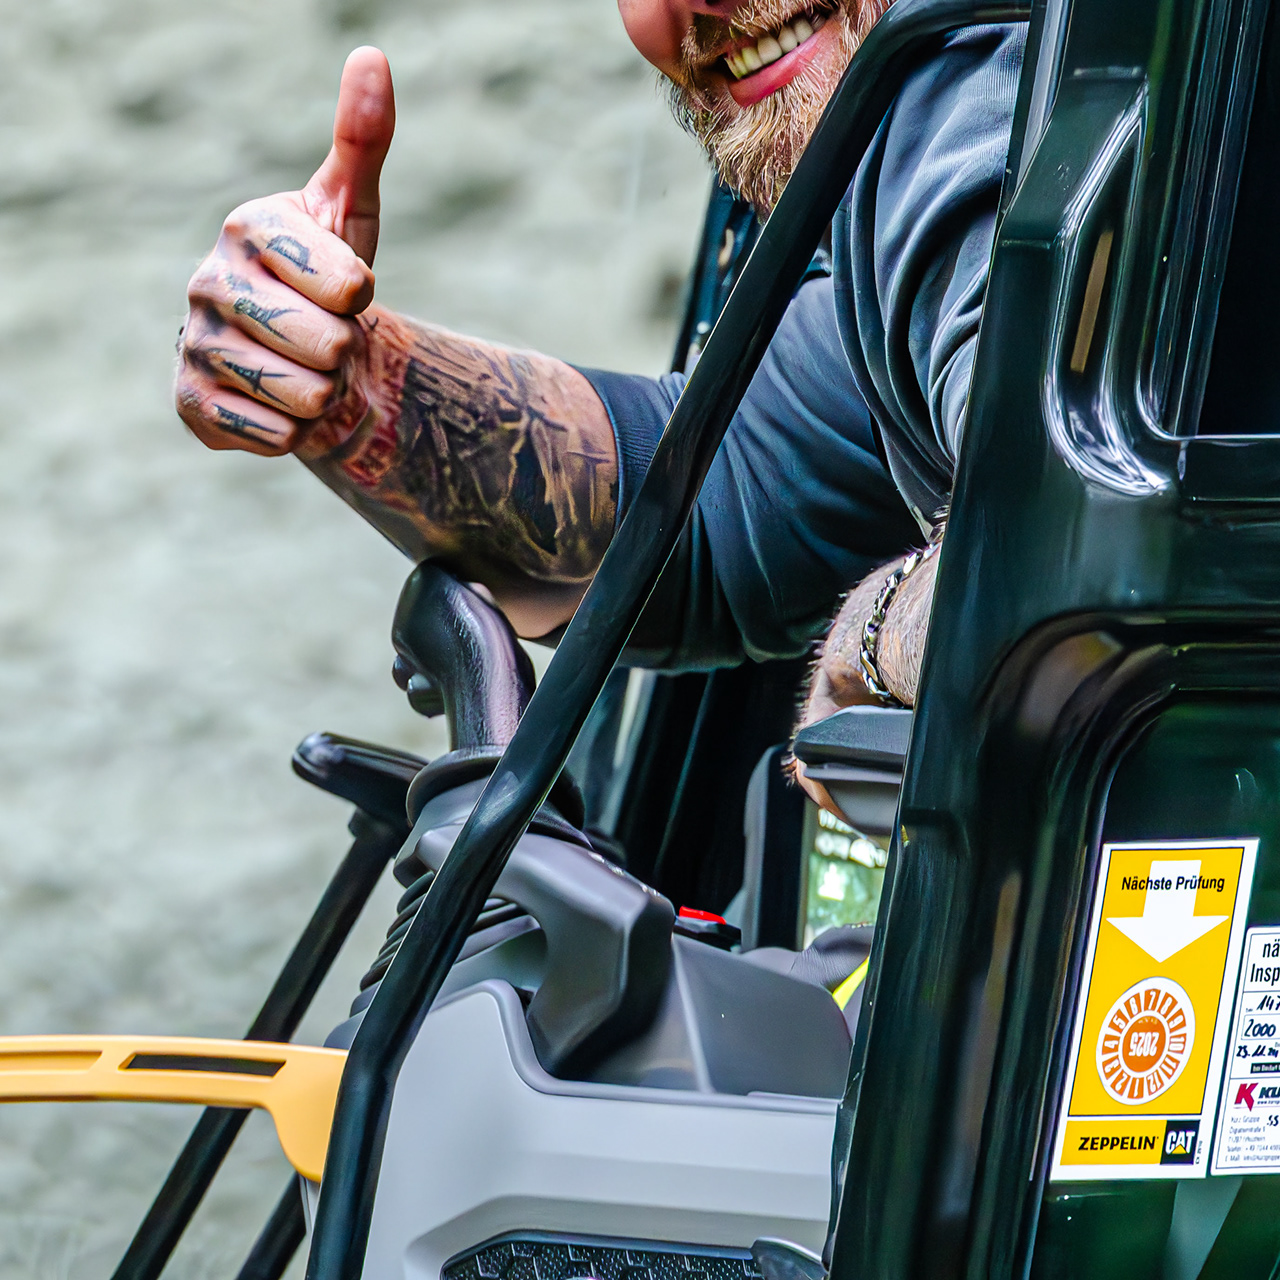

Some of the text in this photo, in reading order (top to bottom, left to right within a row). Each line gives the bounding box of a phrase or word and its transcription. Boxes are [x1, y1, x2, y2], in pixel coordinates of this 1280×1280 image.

[1121, 875, 1225, 892] Nächste Prüfung
[1148, 990, 1157, 1010] 7
[1160, 996, 1173, 1015] 8
[1112, 1015, 1126, 1029] 5
[1169, 1014, 1184, 1027] 9
[1244, 1018, 1277, 1037] 2000
[1104, 1039, 1119, 1049] 4
[1128, 1031, 1160, 1057] 2025
[1169, 1036, 1185, 1051] 10
[1104, 1058, 1119, 1073] 3
[1163, 1056, 1177, 1074] 11
[1114, 1072, 1129, 1091] 2
[1147, 1073, 1162, 1093] 12
[1078, 1136, 1156, 1151] ZEPPELIN
[1165, 1130, 1196, 1155] CAT
